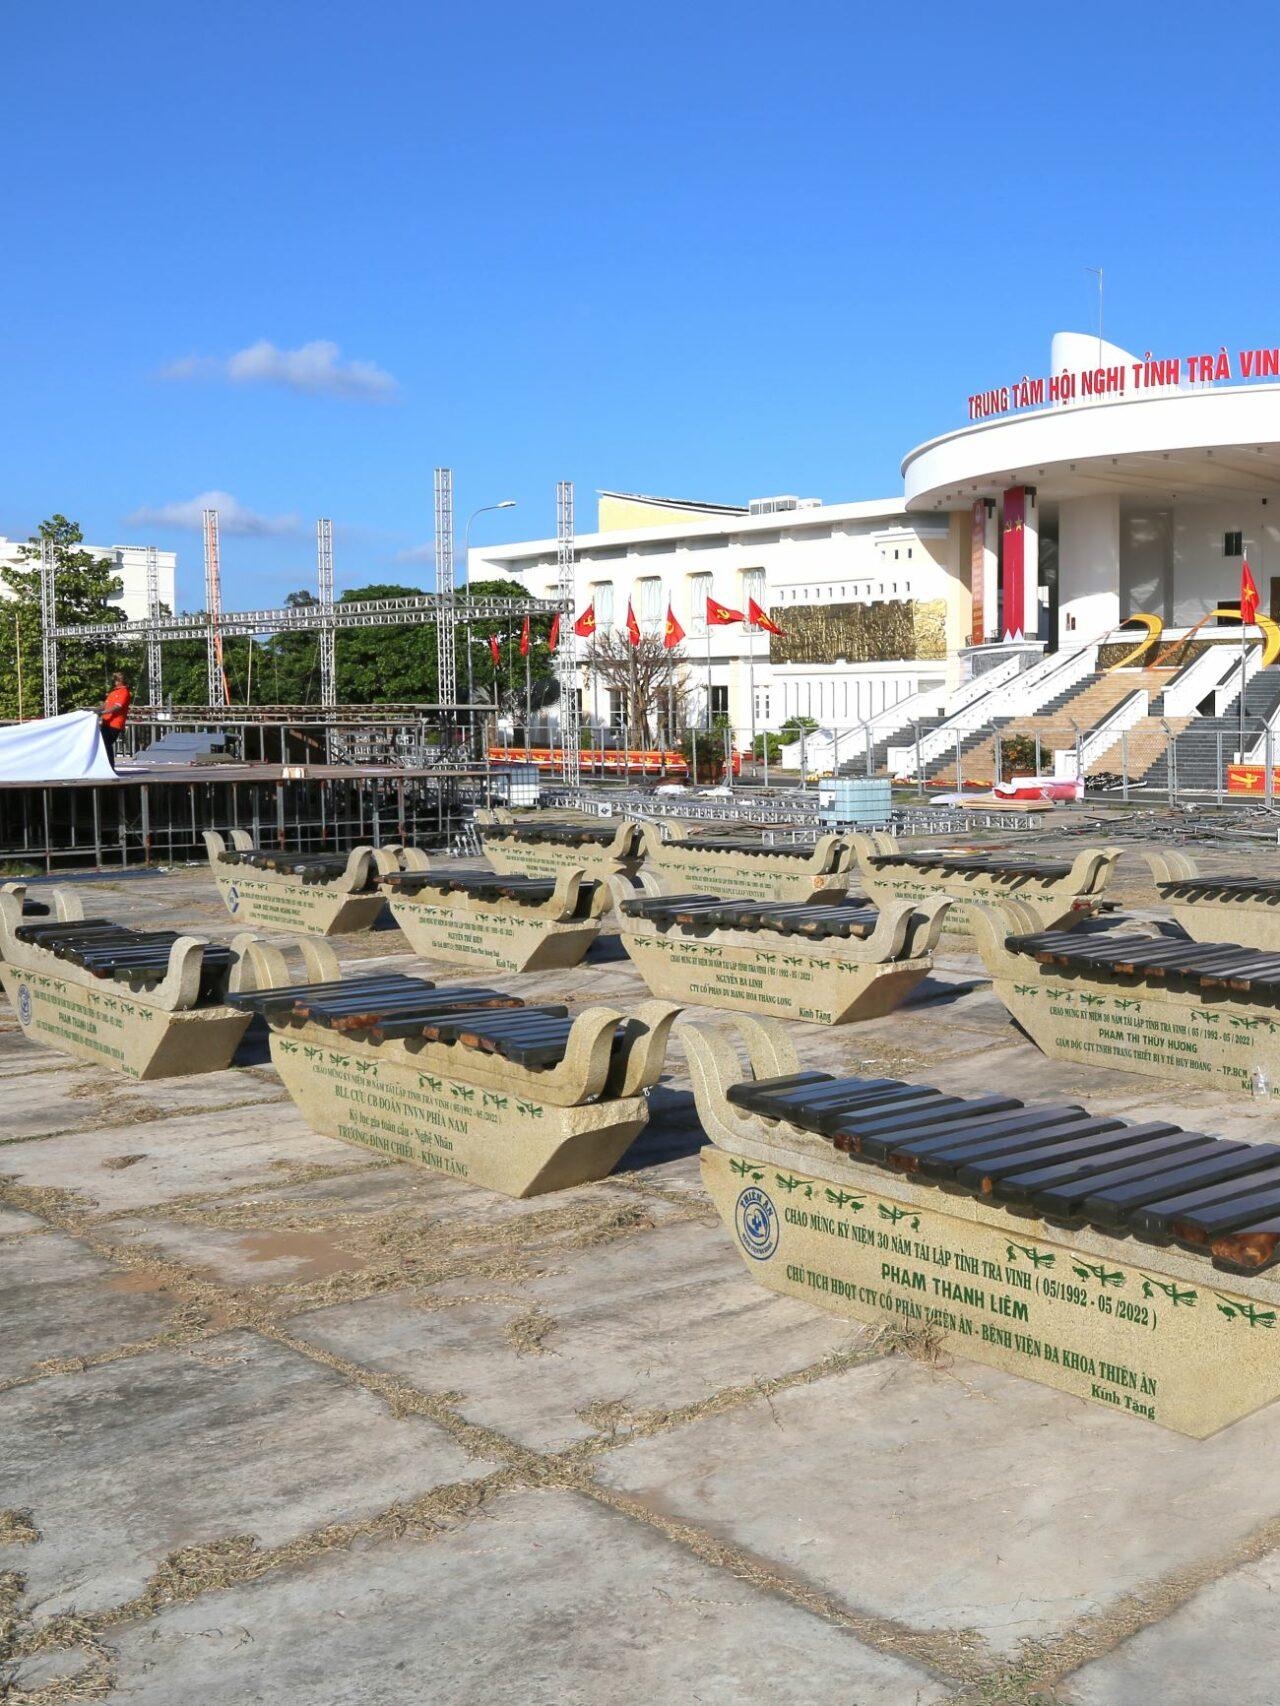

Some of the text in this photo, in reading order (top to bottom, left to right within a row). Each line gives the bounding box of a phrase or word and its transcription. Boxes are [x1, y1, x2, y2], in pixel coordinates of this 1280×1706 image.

[968, 388, 1008, 420] TRUNG
[1012, 376, 1044, 408] TÂM
[1049, 368, 1076, 405] HỘI
[1082, 366, 1125, 396] NGHỊ
[1132, 352, 1180, 388] TỈNH
[1187, 346, 1230, 382] TRÀ
[448, 1117, 468, 1134] NAM
[810, 1211, 834, 1235] MỪNG
[852, 1224, 874, 1248] NIỆM
[878, 1232, 889, 1250] 30
[891, 1233, 911, 1256] NĂM
[932, 1244, 951, 1268] LẬP
[954, 1248, 979, 1275] TỈNH
[1005, 1266, 1032, 1296] VINH
[1043, 1280, 1087, 1308] 05/1992
[1098, 1294, 1112, 1314] 05
[882, 1262, 1029, 1322] PHẠM THANH LIÊM
[786, 1264, 805, 1284] CHỦ
[807, 1270, 828, 1291] TỊCH
[831, 1275, 857, 1299] HĐQT
[859, 1286, 878, 1306] CTY
[982, 1324, 1012, 1348] BỆNH
[1015, 1334, 1041, 1359] VIỆN
[1045, 1343, 1059, 1364] ĐA
[1062, 1349, 1095, 1376] KHOA
[1099, 1361, 1137, 1390] THIÊN
[1140, 1372, 1157, 1396] ÂN
[1091, 1383, 1155, 1420] Kính Tặng
